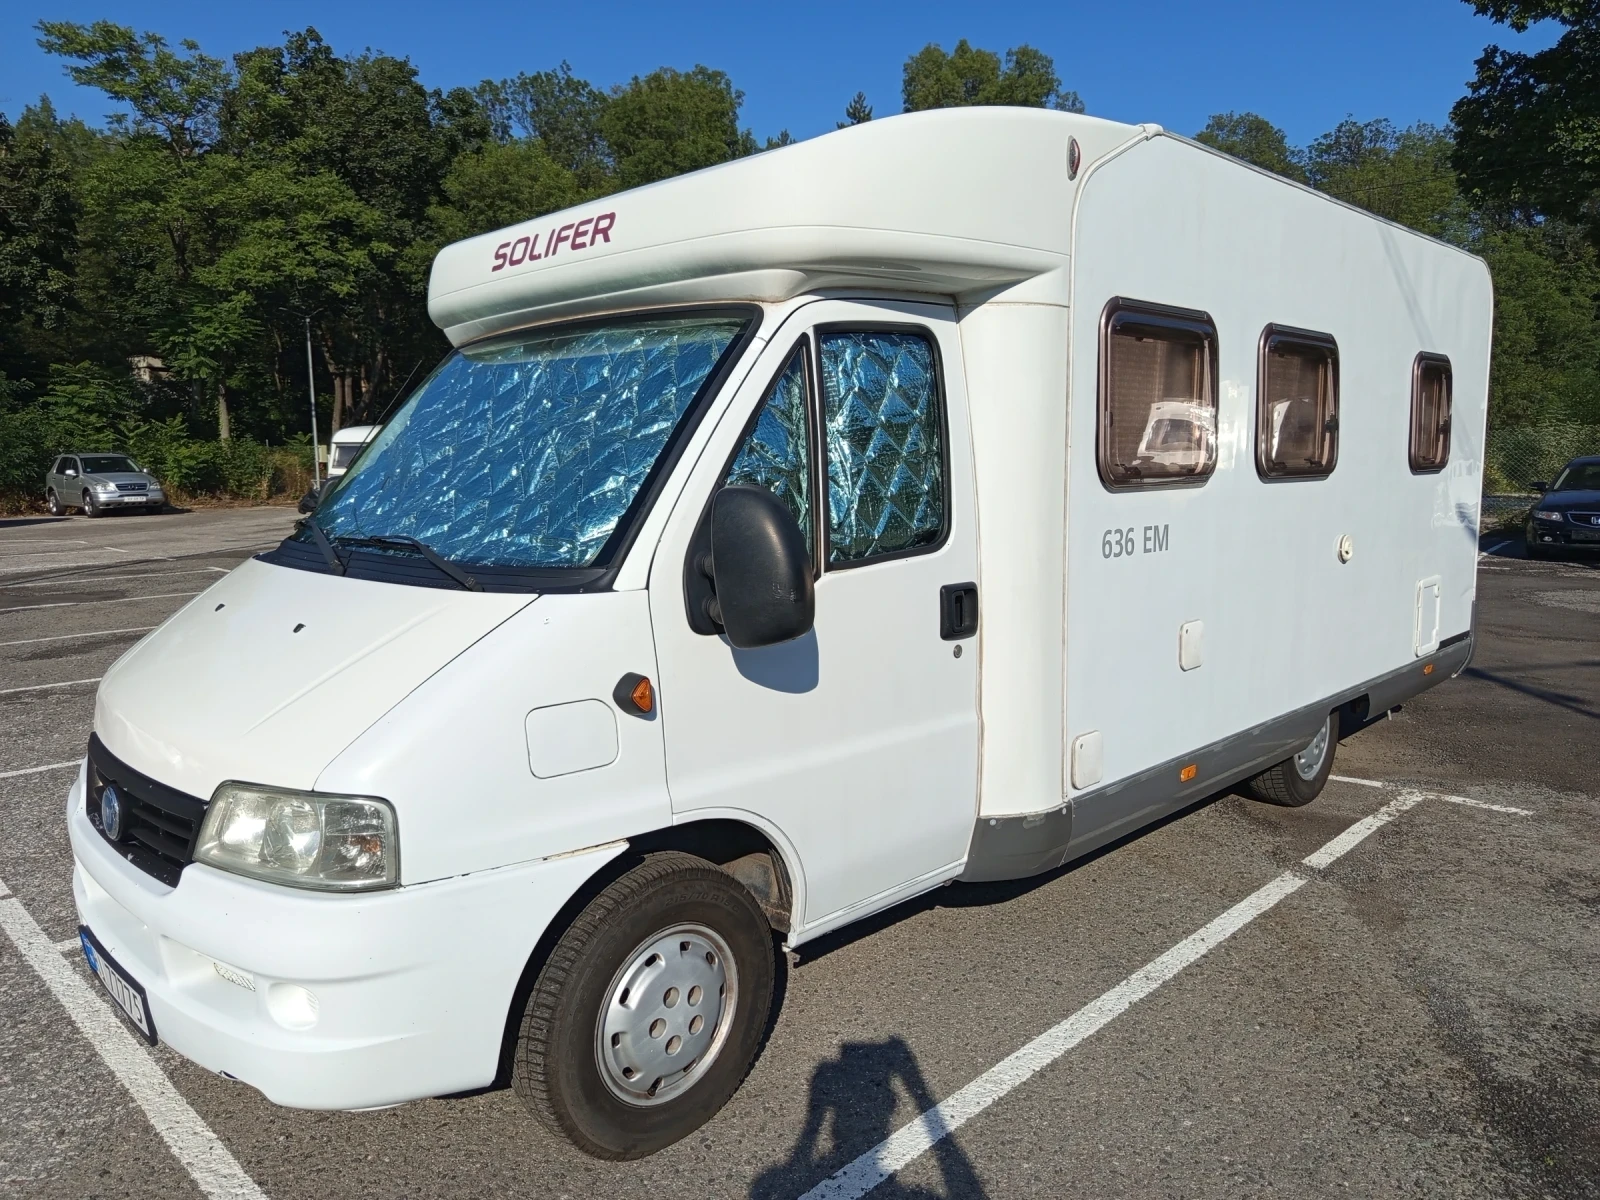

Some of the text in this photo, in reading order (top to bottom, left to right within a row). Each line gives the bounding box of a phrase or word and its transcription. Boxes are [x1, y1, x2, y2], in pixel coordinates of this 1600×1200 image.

[491, 211, 617, 273] SOLIFER
[1101, 524, 1169, 559] 636 EM
